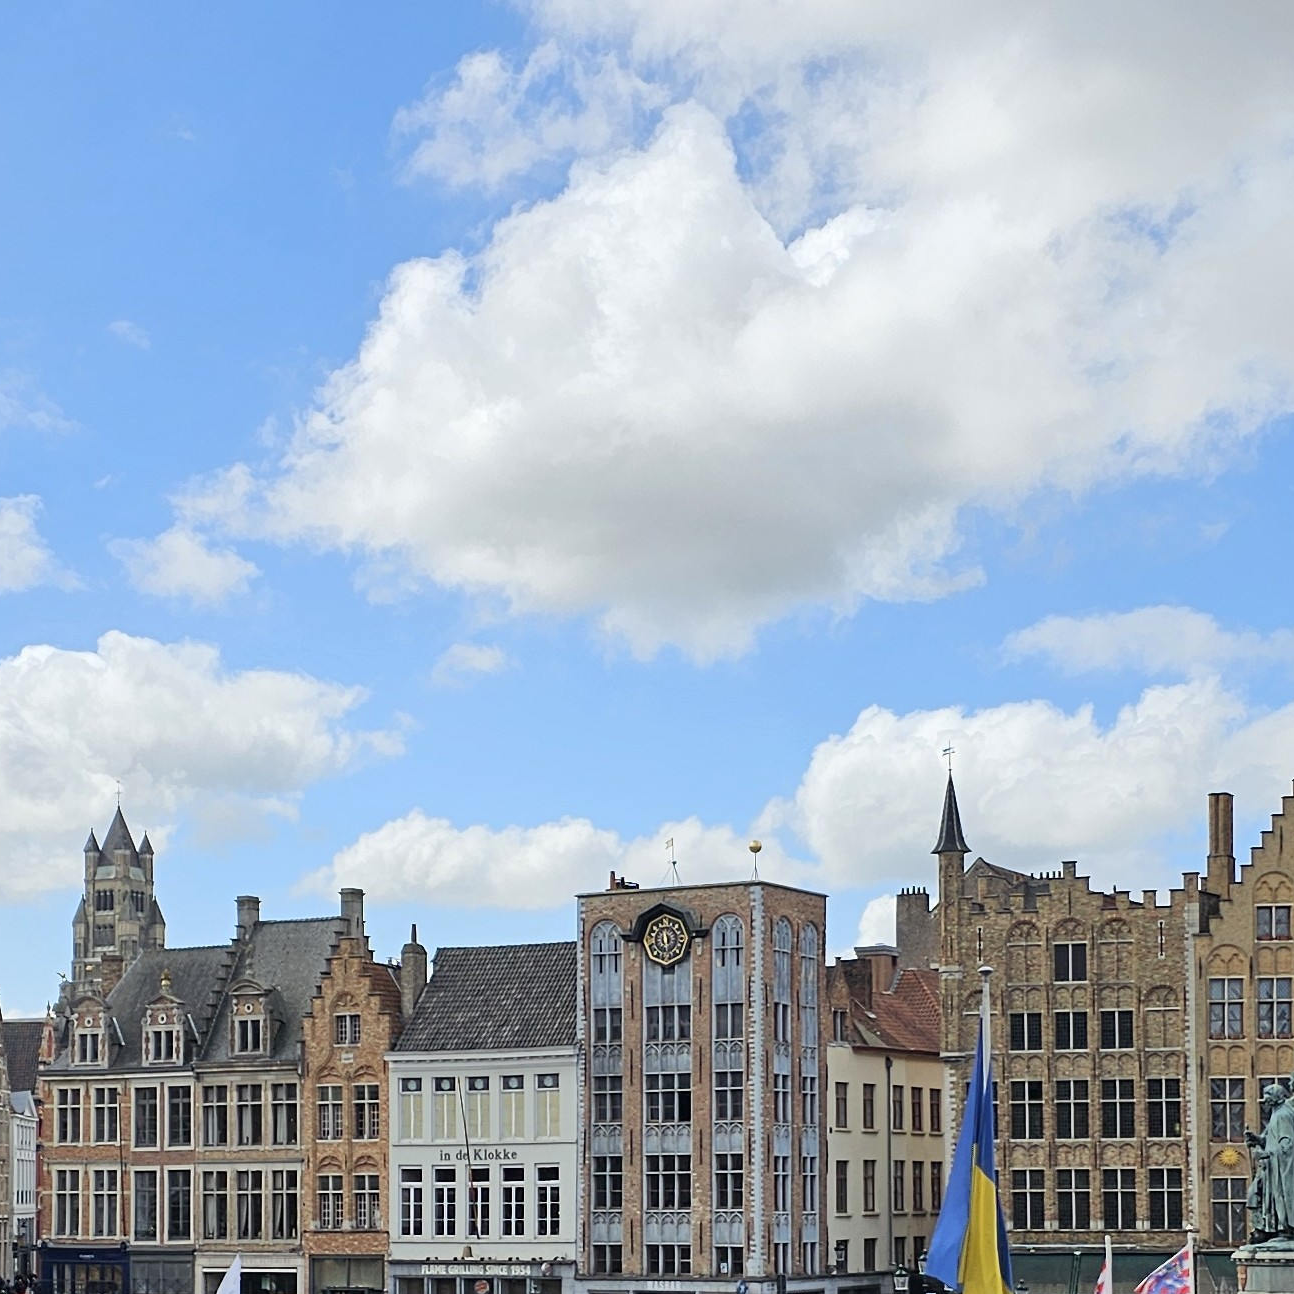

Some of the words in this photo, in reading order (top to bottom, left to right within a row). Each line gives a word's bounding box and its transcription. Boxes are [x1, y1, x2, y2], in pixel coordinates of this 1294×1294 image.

[440, 1149, 451, 1161] in
[473, 1148, 518, 1161] Klokke
[421, 1265, 447, 1275] FLAME
[448, 1264, 484, 1275] GRILLING
[485, 1264, 508, 1275] SINCE
[510, 1264, 531, 1275] 1954
